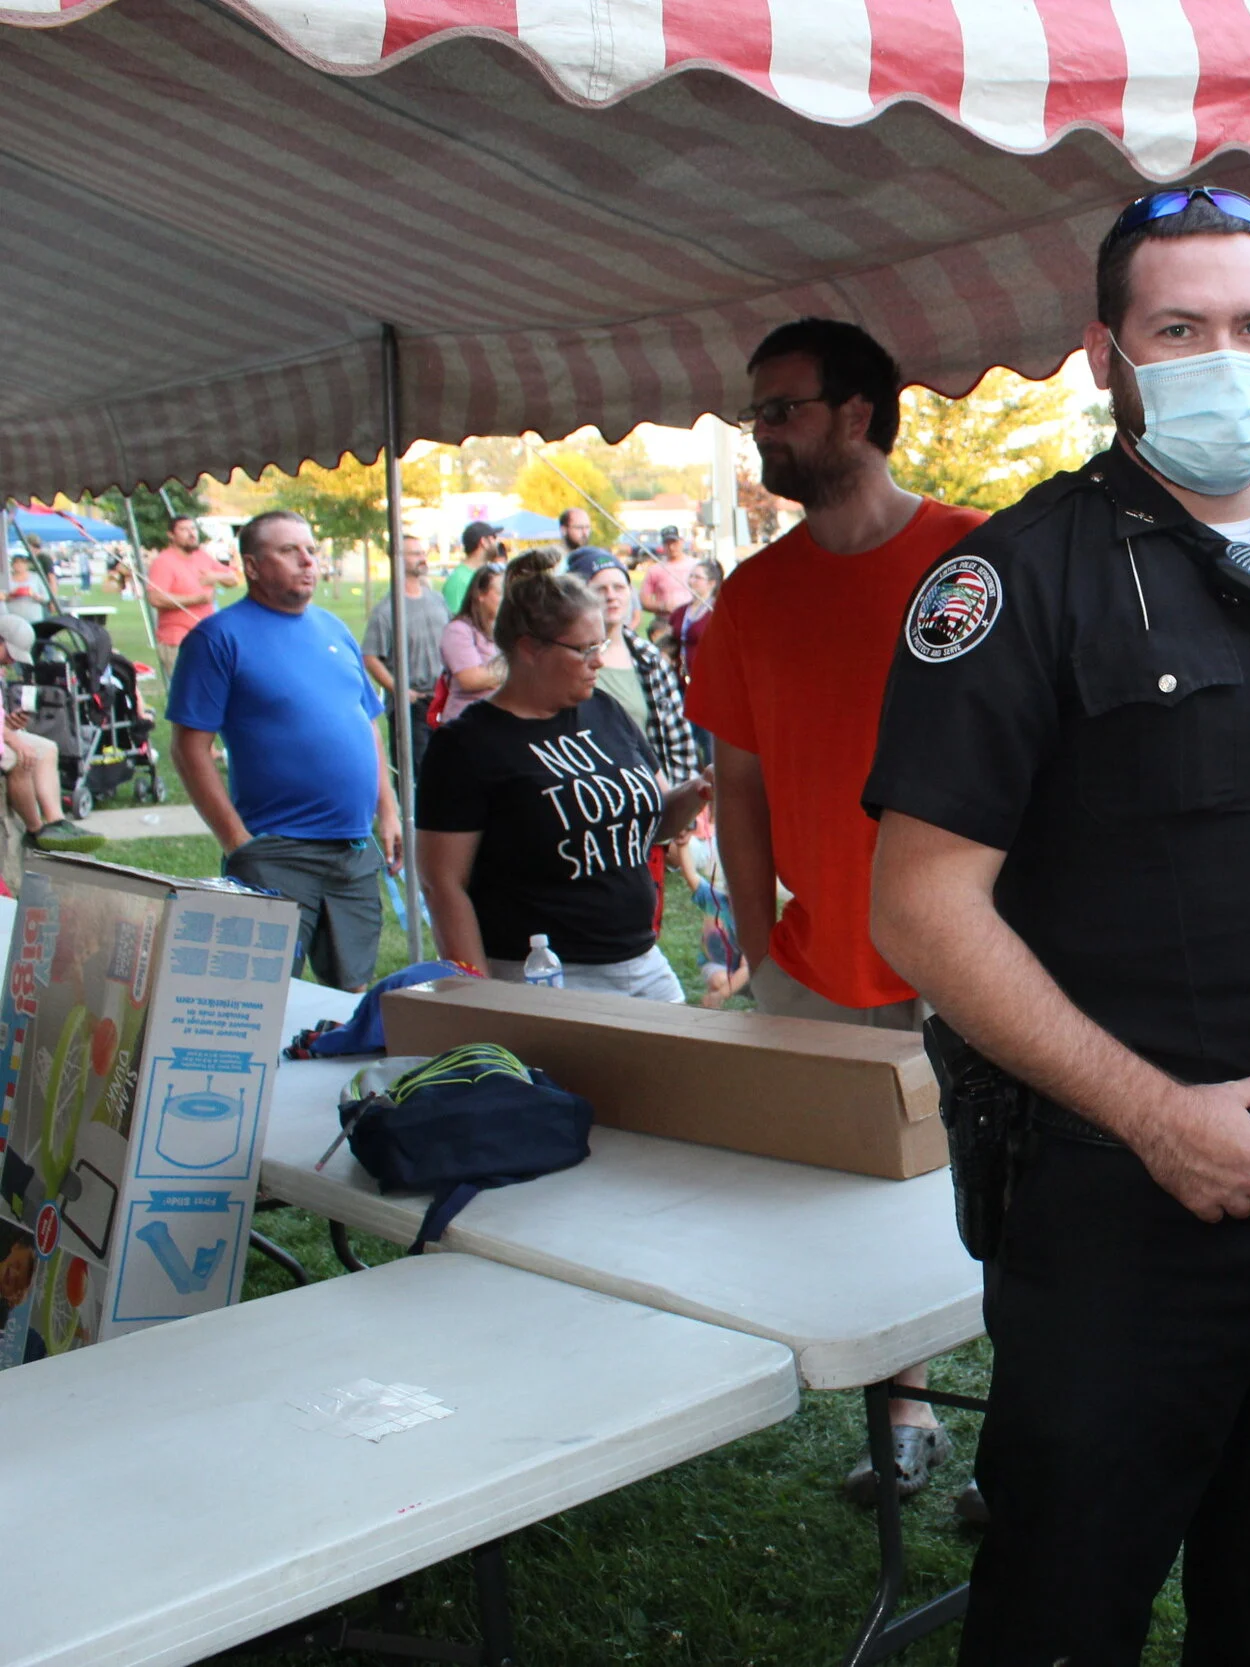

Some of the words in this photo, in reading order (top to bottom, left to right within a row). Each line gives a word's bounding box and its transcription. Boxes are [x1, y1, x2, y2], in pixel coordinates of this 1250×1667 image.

[960, 561, 976, 570] POLICE
[913, 636, 930, 654] PROTECT
[931, 649, 942, 658] AND
[943, 645, 962, 656] SERVE
[528, 729, 614, 779] NOT
[541, 765, 662, 831] TODAY
